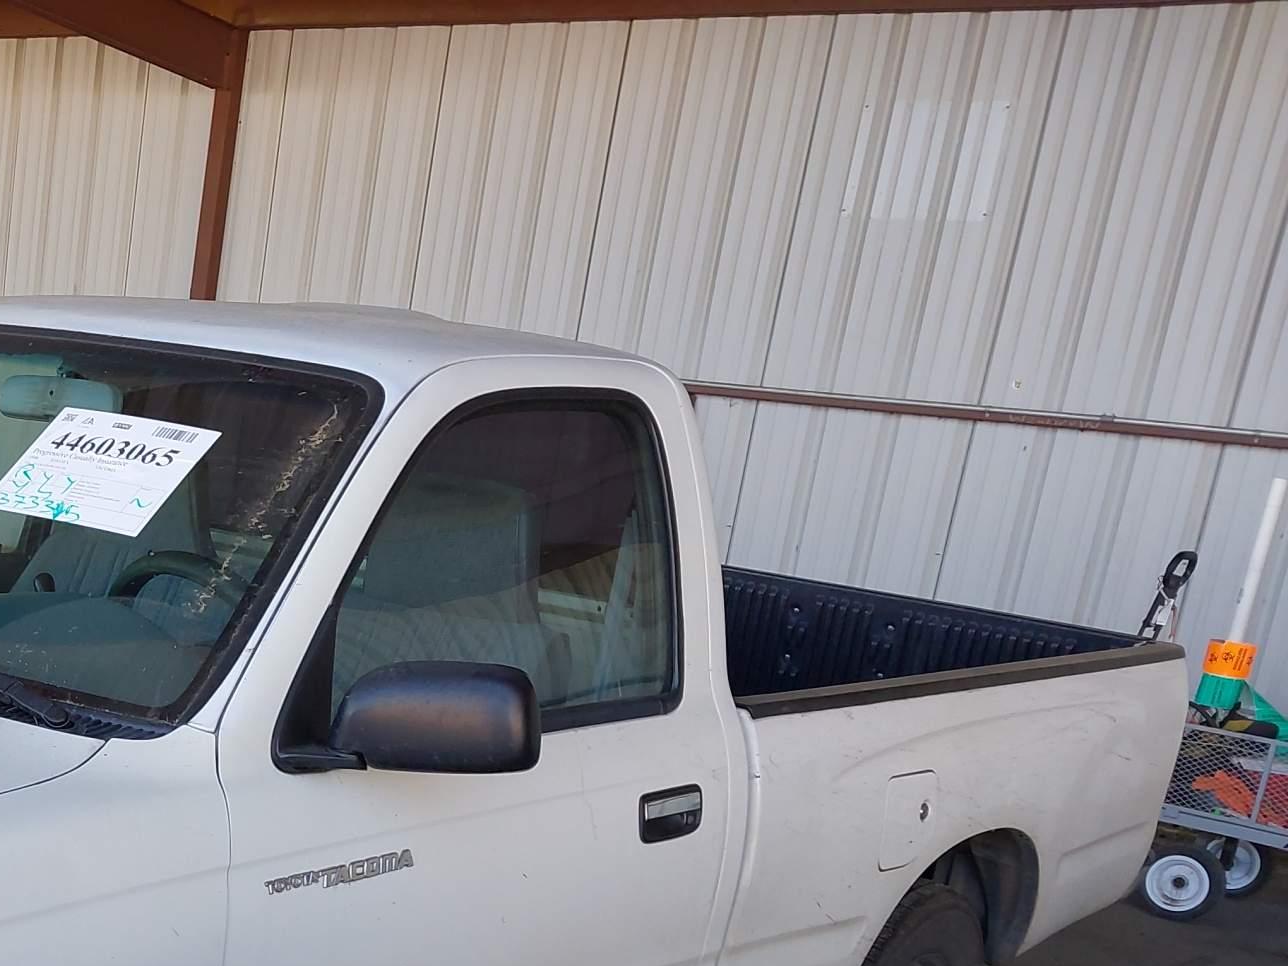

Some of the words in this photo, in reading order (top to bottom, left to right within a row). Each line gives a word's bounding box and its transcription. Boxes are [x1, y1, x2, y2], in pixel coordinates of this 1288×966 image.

[51, 431, 182, 467] 44603065
[265, 870, 319, 895] TOYOTA
[318, 849, 414, 888] TACOMA
